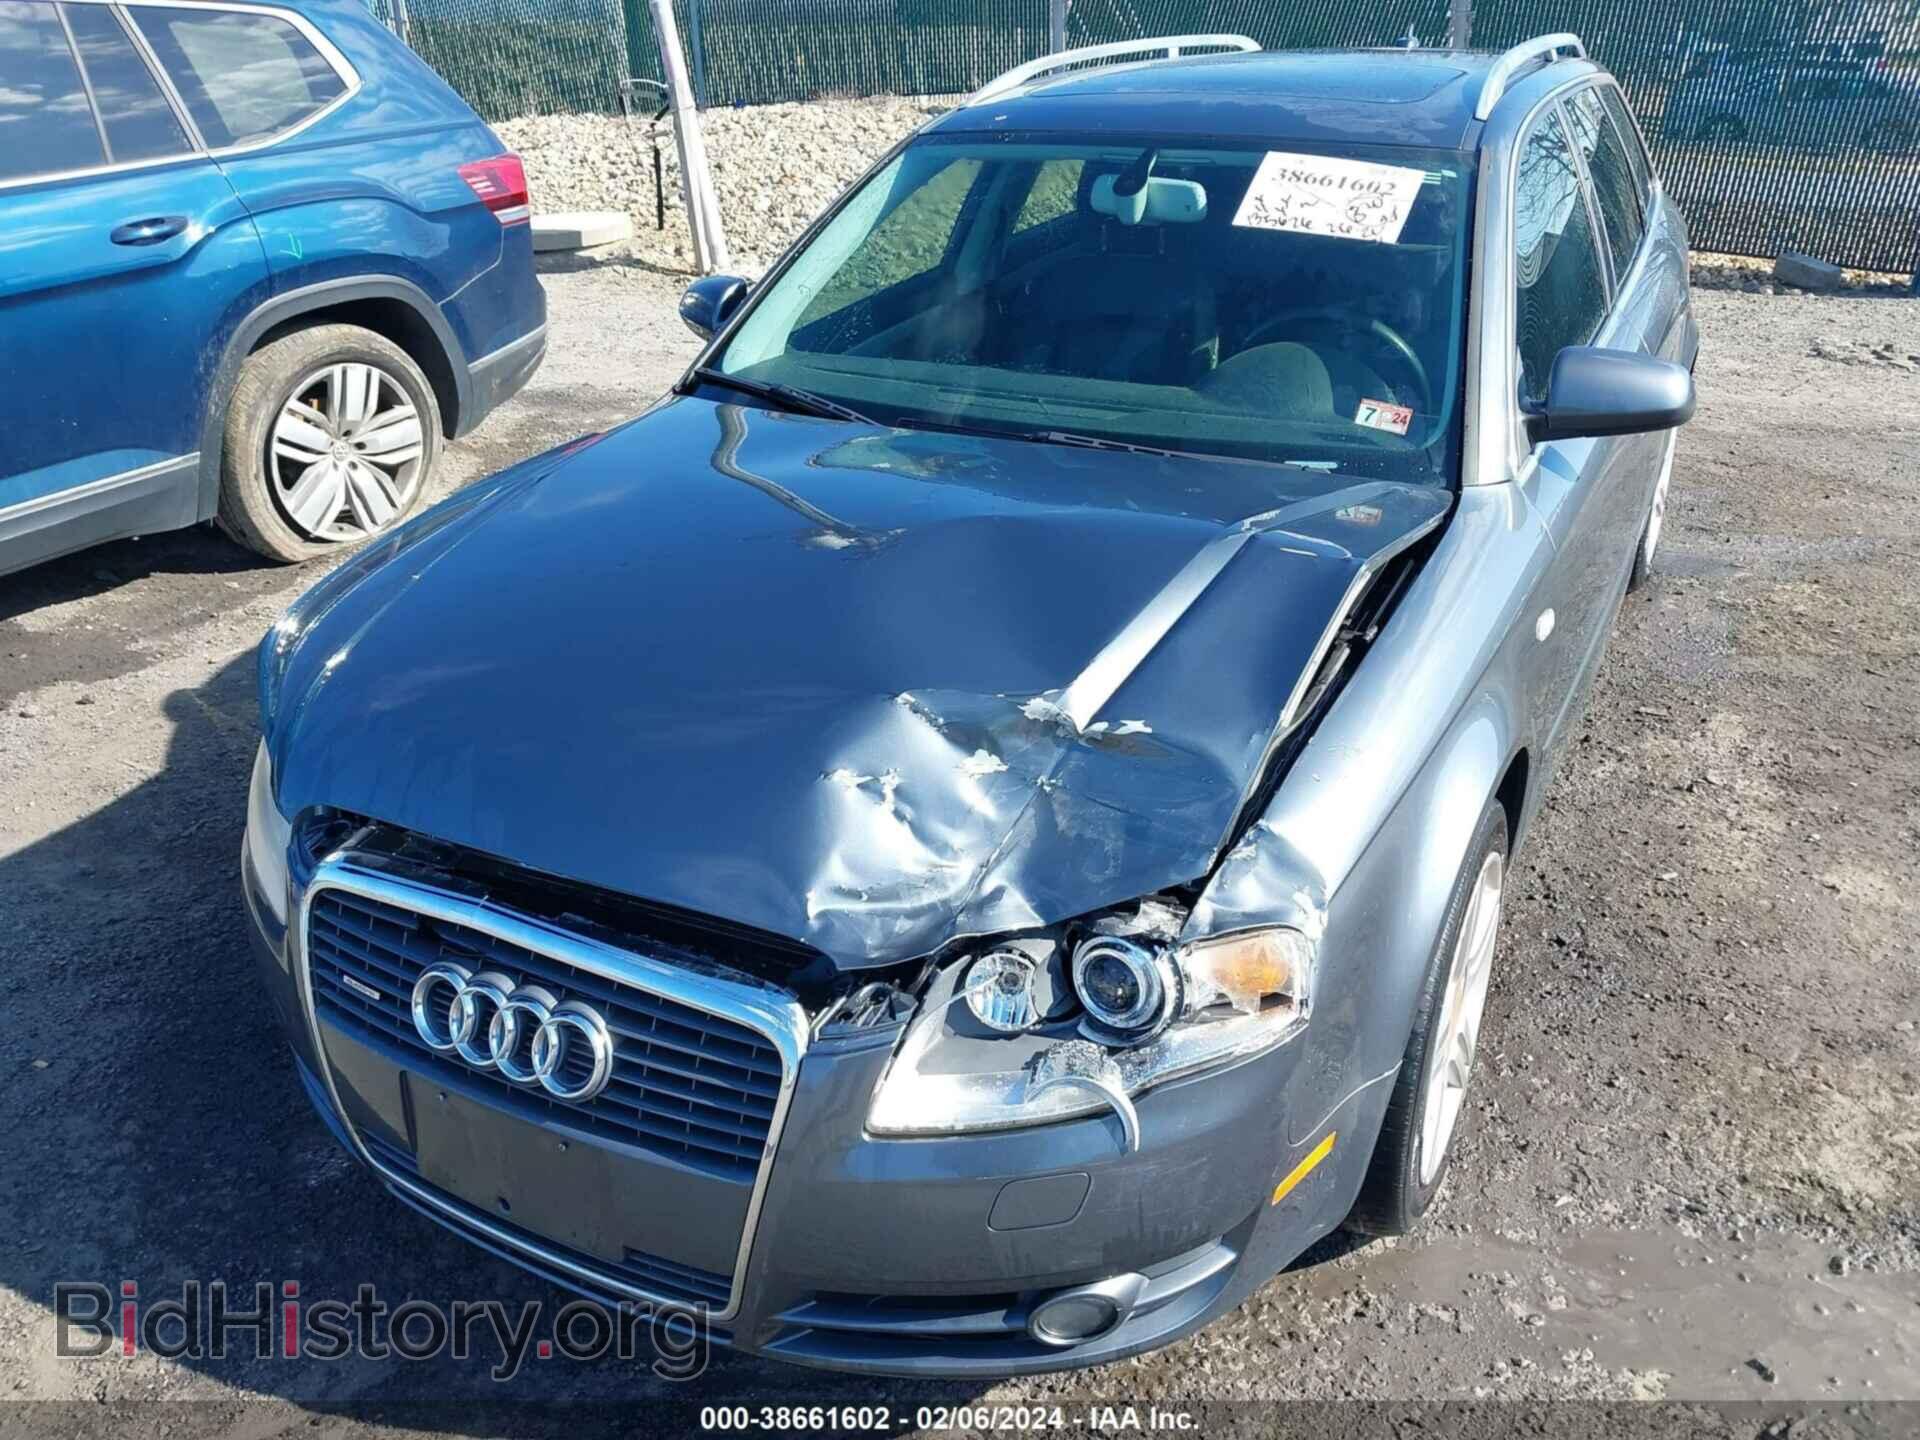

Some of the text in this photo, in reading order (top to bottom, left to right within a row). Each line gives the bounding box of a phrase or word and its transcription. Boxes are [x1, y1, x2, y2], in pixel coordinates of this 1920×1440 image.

[1271, 168, 1397, 196] 38661602
[1364, 406, 1409, 426] 7 24
